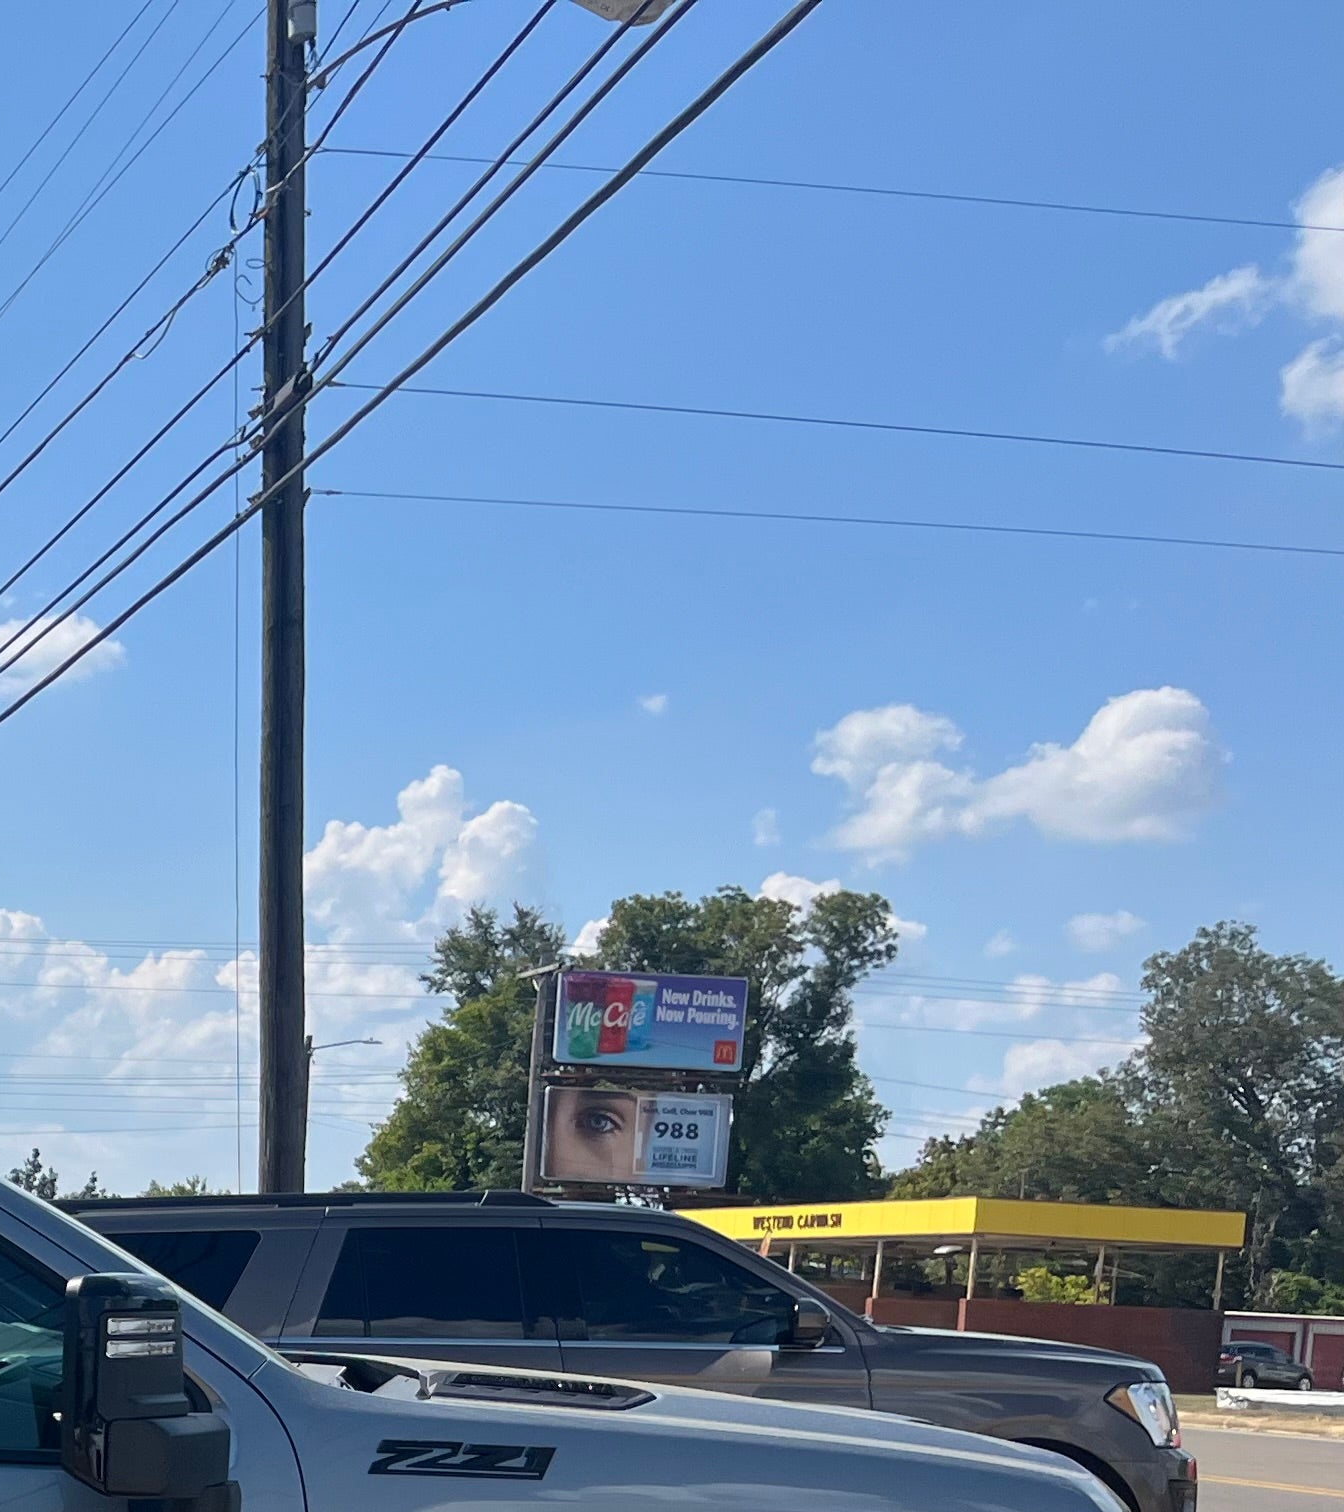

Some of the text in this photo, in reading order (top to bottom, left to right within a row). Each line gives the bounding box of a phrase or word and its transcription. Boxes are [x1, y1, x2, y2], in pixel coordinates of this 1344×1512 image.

[662, 988, 737, 1008] New Drinks.
[656, 1006, 685, 1023] Now
[654, 1121, 699, 1140] 988
[367, 1439, 558, 1481] Z71
